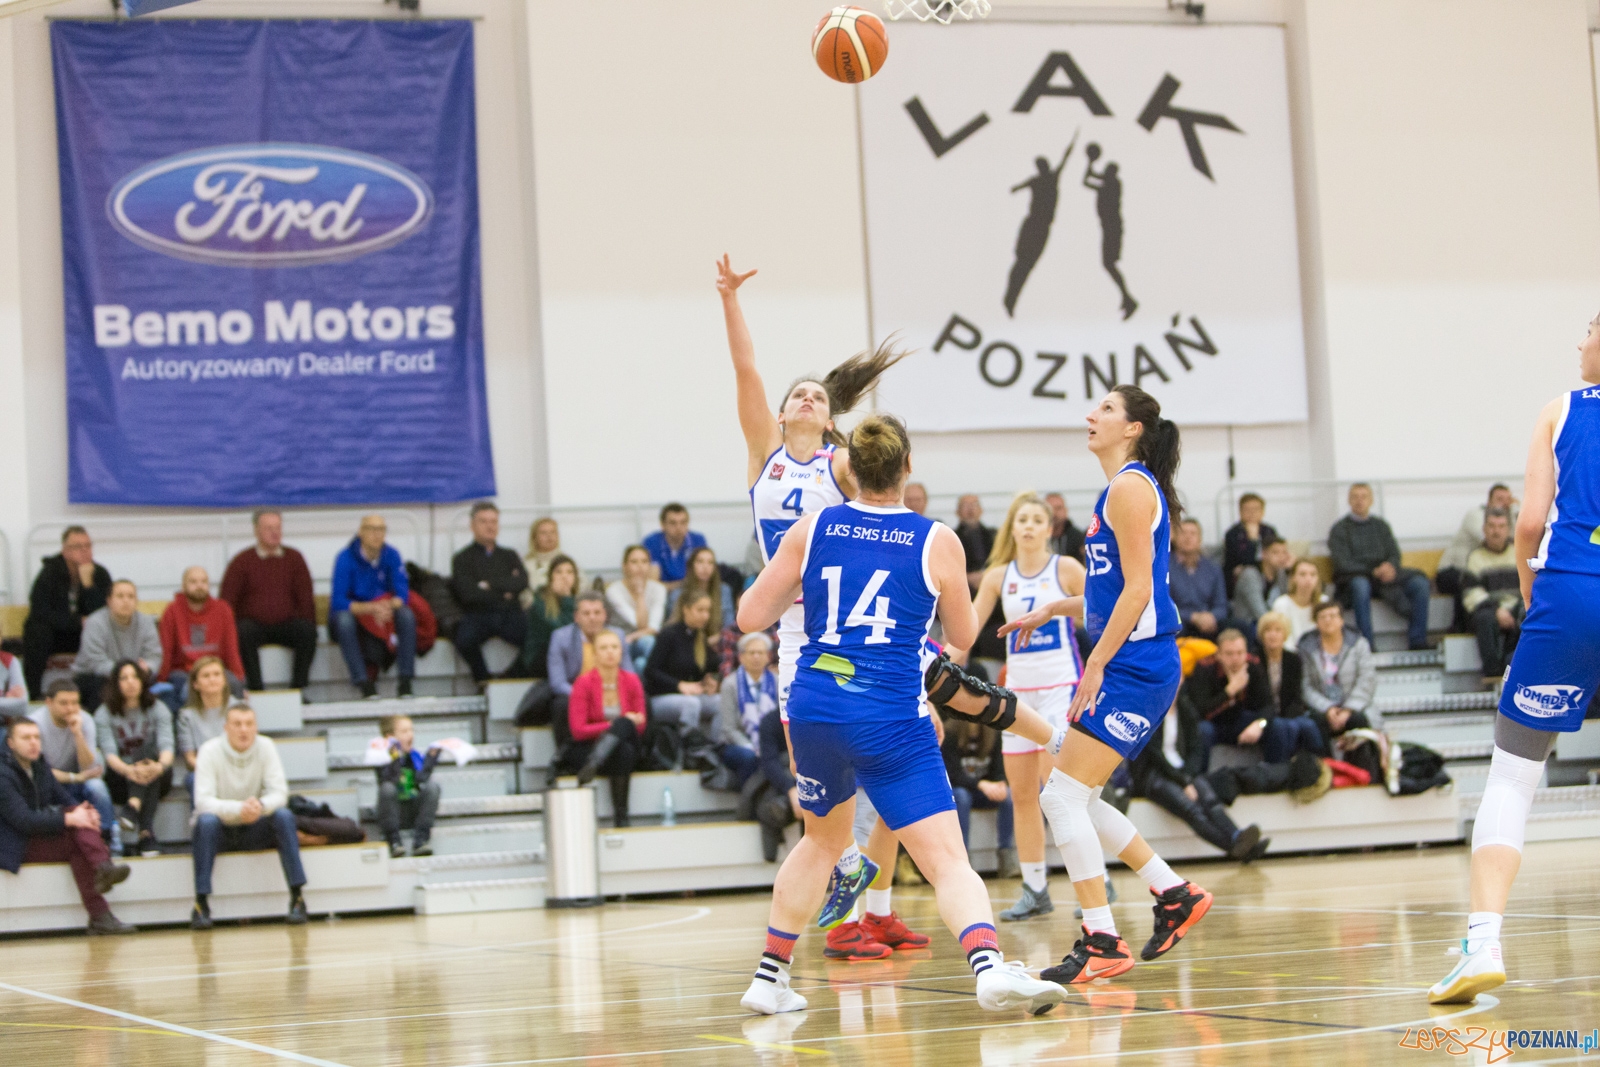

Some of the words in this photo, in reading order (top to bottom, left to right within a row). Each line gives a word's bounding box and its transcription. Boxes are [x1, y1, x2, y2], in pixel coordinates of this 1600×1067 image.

[903, 49, 1247, 184] LAK
[174, 162, 368, 243] Ford
[93, 303, 253, 349] Bemo
[264, 299, 456, 342] Motors
[121, 356, 295, 382] Autoryzowany
[299, 353, 375, 376] Dealer
[380, 350, 436, 374] Ford
[931, 311, 1219, 400] POZNAŃ
[781, 487, 804, 517] 4
[825, 523, 851, 537] ŁKS
[852, 526, 880, 541] SMS
[881, 528, 915, 546] ŁÓDŹ
[1085, 543, 1113, 577] 15
[818, 565, 897, 646] 14
[1021, 596, 1036, 613] 7
[1517, 683, 1585, 709] TOMADEX
